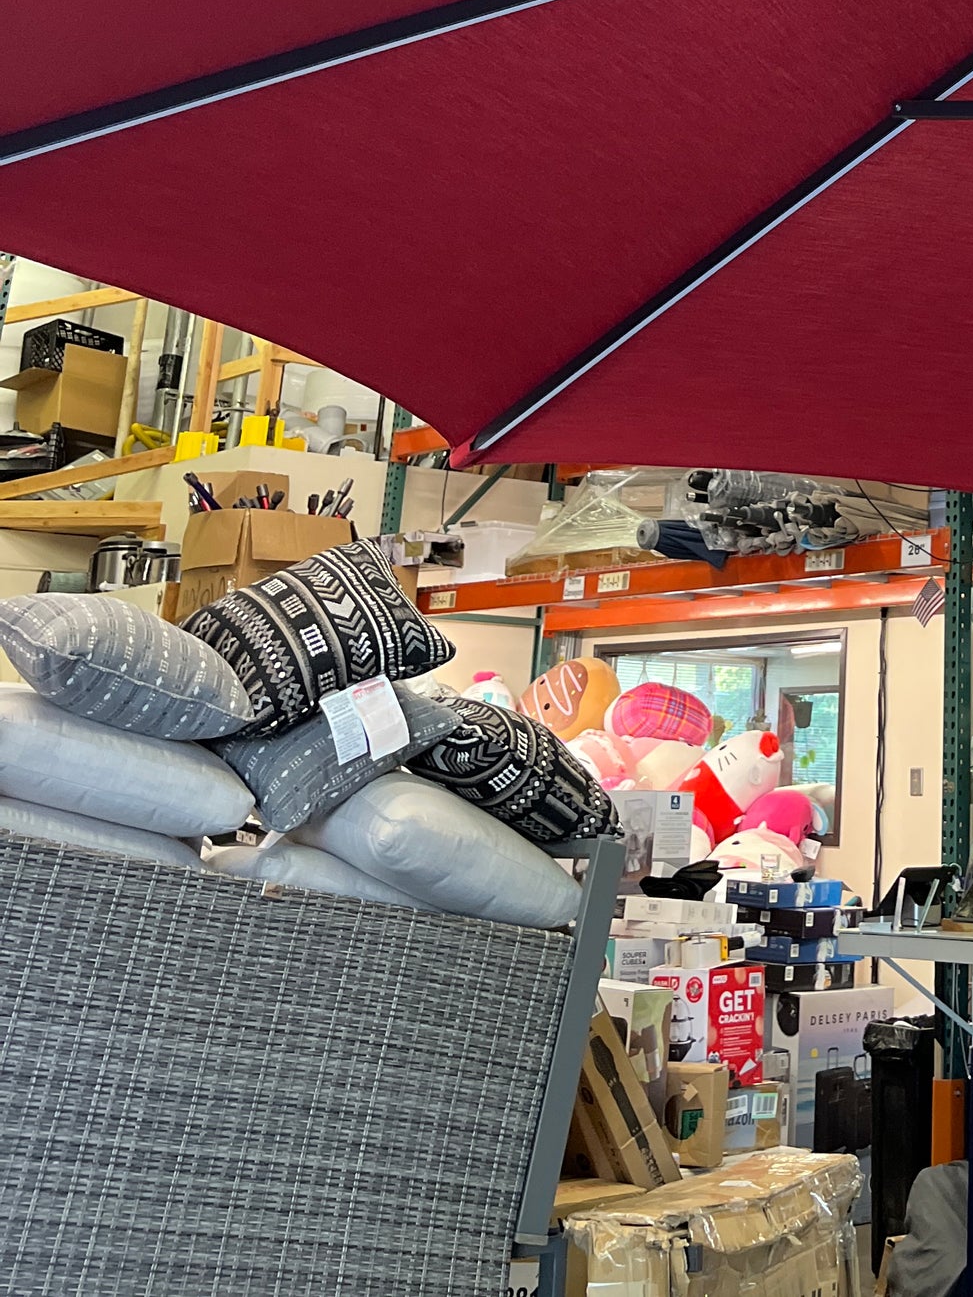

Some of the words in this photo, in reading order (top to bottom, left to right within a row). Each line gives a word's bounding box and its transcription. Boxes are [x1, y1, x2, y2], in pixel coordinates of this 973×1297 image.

[622, 951, 647, 959] SOUPER
[621, 958, 642, 966] CUBES
[719, 989, 755, 1013] GET
[810, 1013, 852, 1026] DELSEY
[856, 1009, 888, 1022] PARIS
